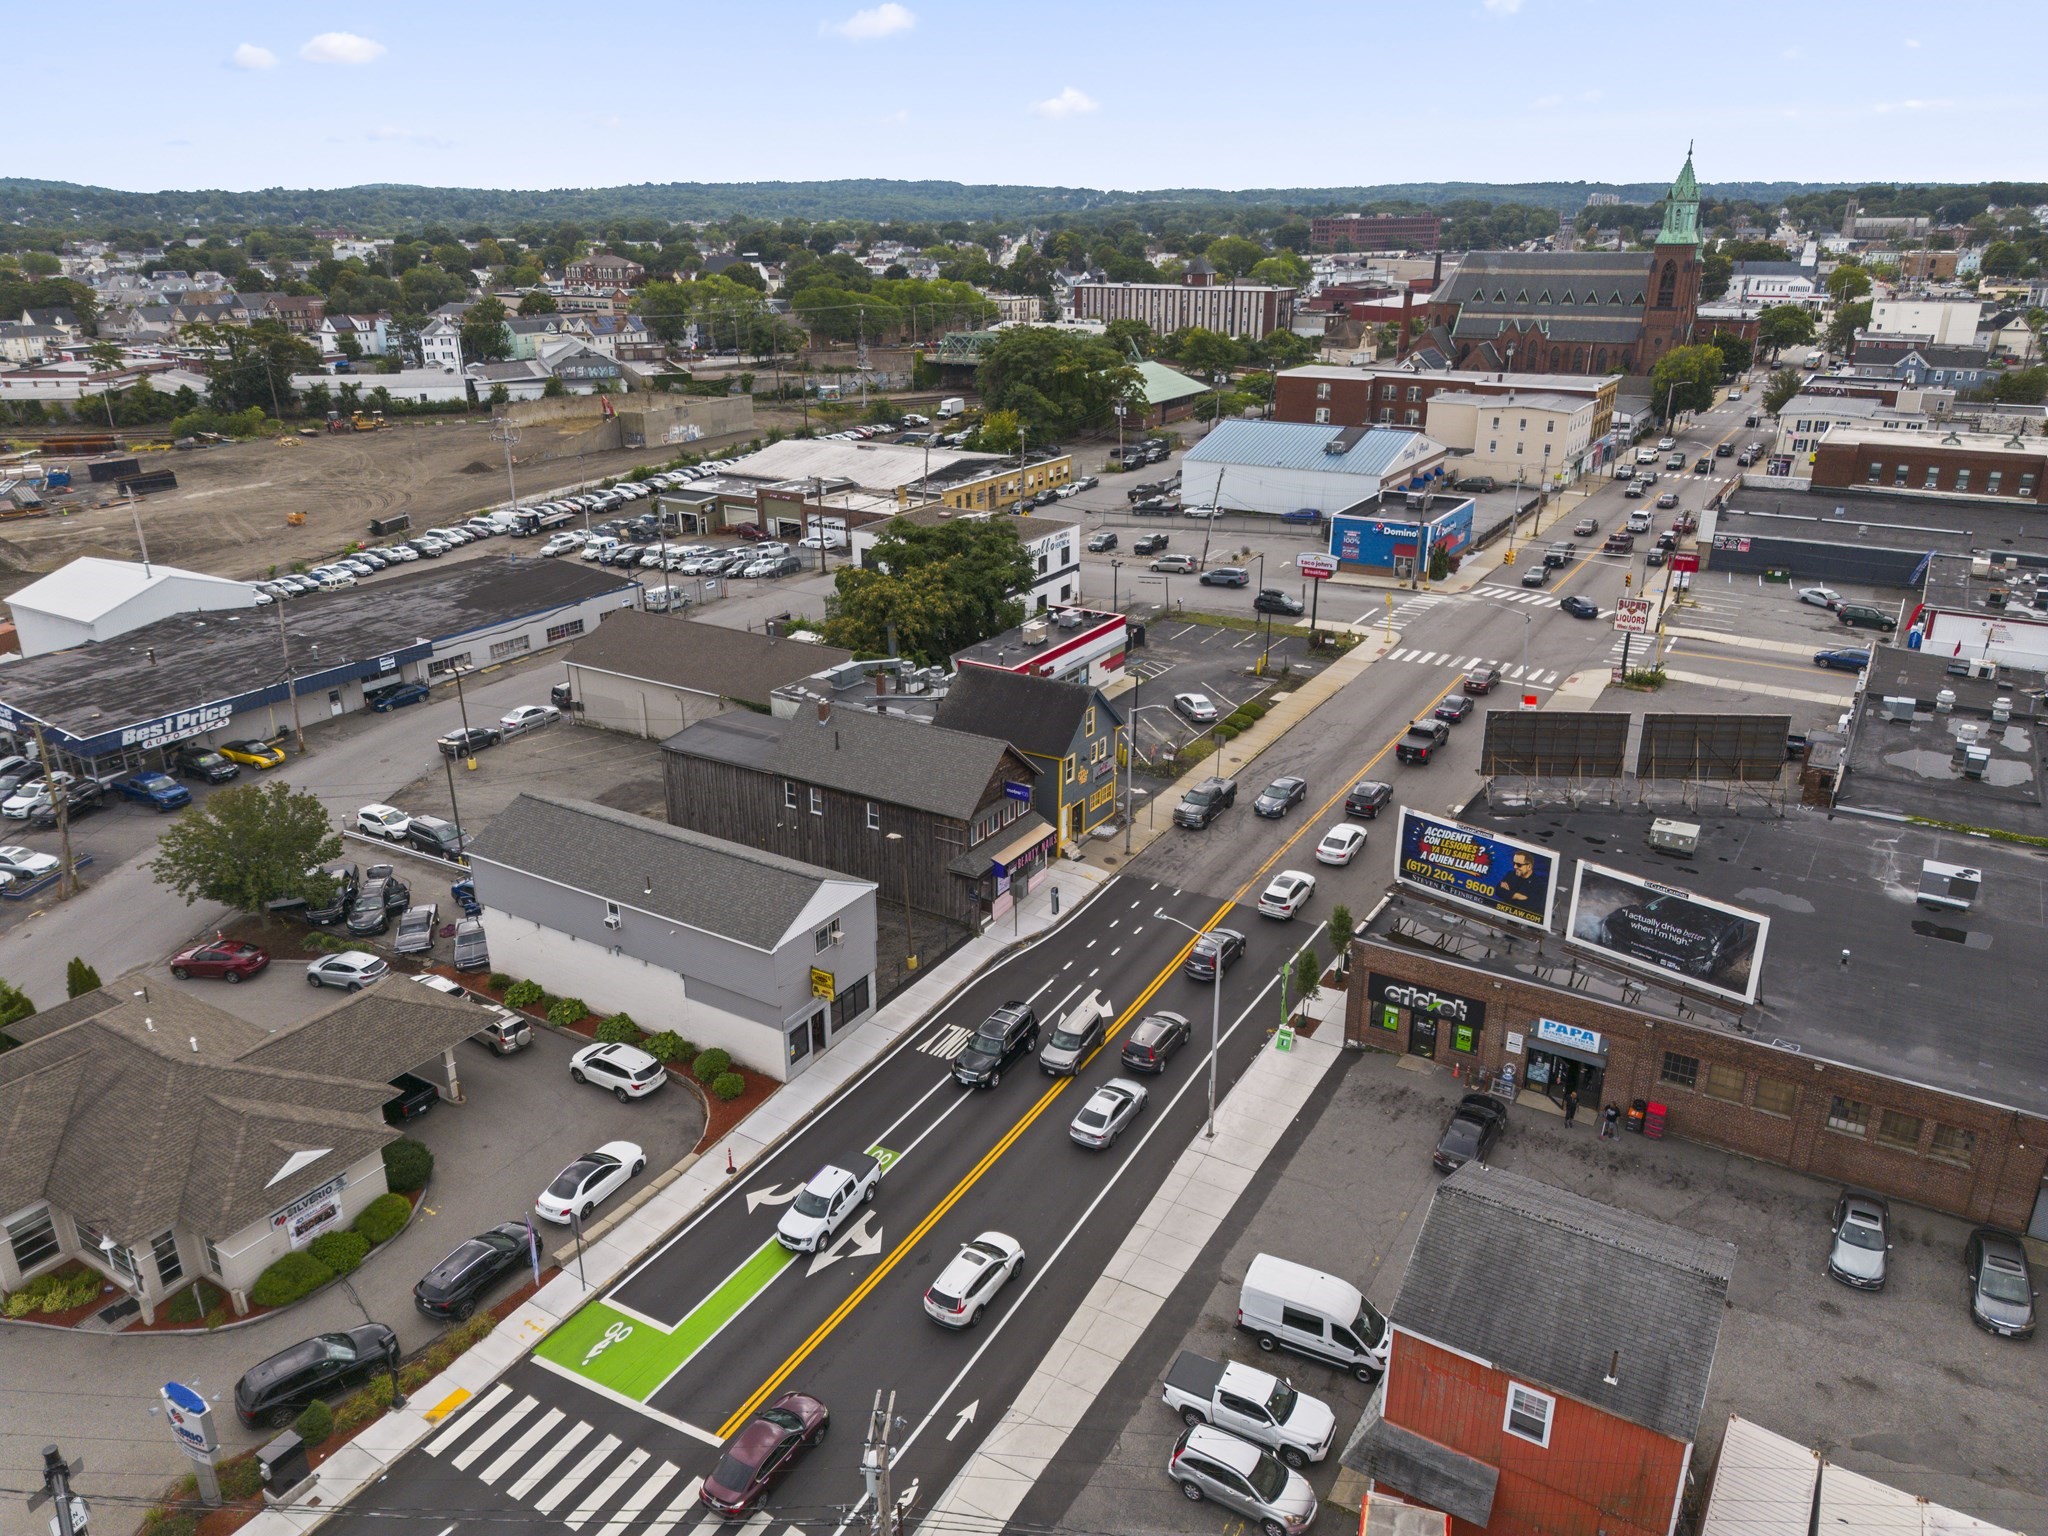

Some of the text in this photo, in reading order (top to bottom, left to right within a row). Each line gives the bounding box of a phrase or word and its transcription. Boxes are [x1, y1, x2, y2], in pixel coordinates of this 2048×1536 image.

[1383, 526, 1419, 538] Domino'
[1304, 568, 1328, 576] Breakfast
[1618, 600, 1647, 614] SUPER
[1616, 614, 1645, 625] LIQUORS
[121, 704, 232, 746] Best Price
[146, 718, 227, 748] AUTO SALES
[1424, 835, 1441, 846] CON
[1441, 839, 1478, 854] LESIONES
[1425, 826, 1473, 844] ACCIDENTE
[1017, 834, 1057, 869] BEAUTY NAILS
[1441, 847, 1450, 855] TU
[1453, 851, 1476, 861] SABES
[1420, 851, 1489, 875] A QUIEN LLAMAR
[1406, 859, 1432, 877] (617)
[1433, 868, 1455, 884] 204
[1465, 879, 1495, 897] 9600
[1412, 874, 1439, 889] STEVEN
[1496, 903, 1542, 923] SKFLAW.COM
[1628, 911, 1661, 928] actually
[1661, 921, 1682, 935] drive
[1683, 929, 1706, 941] better
[1630, 921, 1654, 935] when
[1654, 928, 1668, 939] I'm
[1385, 985, 1467, 1021] cricket
[916, 1023, 975, 1060] ONLY
[1543, 1021, 1595, 1042] PAPA
